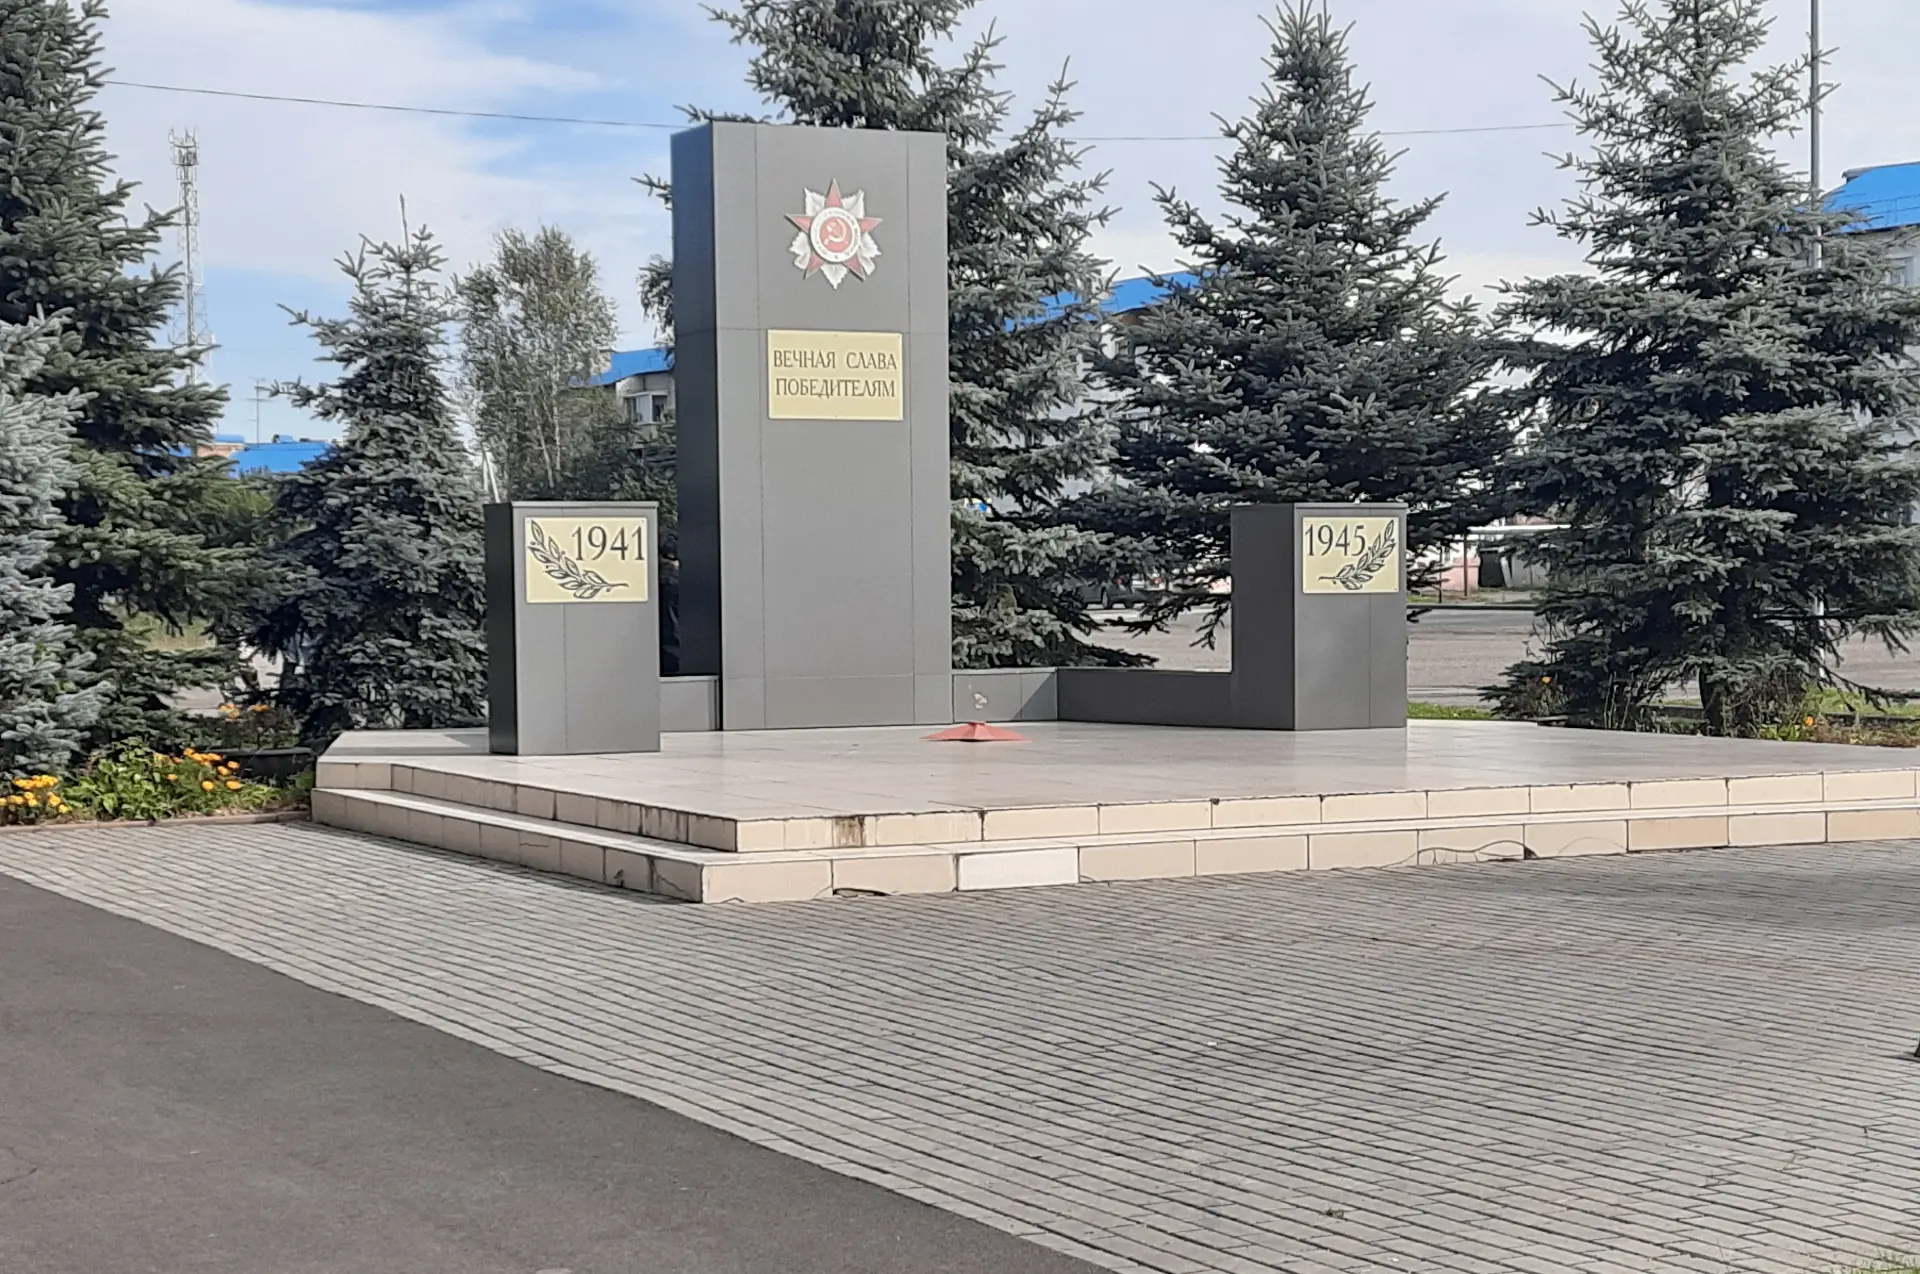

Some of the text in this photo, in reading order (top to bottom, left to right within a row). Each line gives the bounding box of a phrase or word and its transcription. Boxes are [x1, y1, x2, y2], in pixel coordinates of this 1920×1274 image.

[773, 350, 897, 370] ВЕЧНАЯ СЛАВА
[775, 378, 896, 399] ПОБЕДИТЕЛЯМ
[571, 525, 645, 561] 1941
[1305, 523, 1366, 557] 1945
